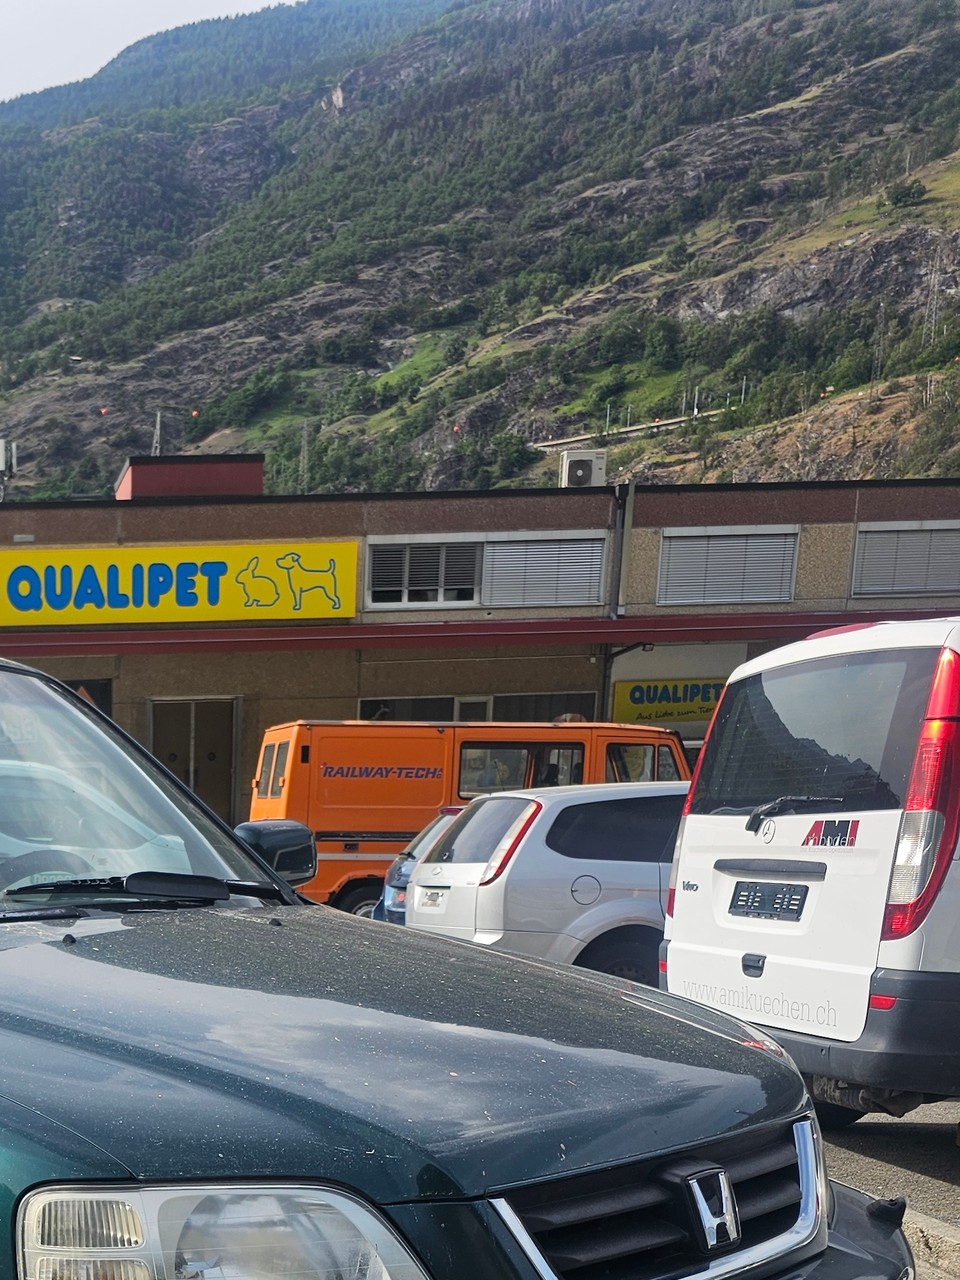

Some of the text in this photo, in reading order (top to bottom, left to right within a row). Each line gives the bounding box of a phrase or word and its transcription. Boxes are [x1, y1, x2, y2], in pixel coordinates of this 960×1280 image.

[6, 561, 228, 612] QUALIPET
[629, 682, 724, 705] QUALIPET
[322, 766, 437, 779] RAILWAY-TECH
[801, 819, 861, 848] AMI
[682, 979, 838, 1027] www.amikuechen.ch
